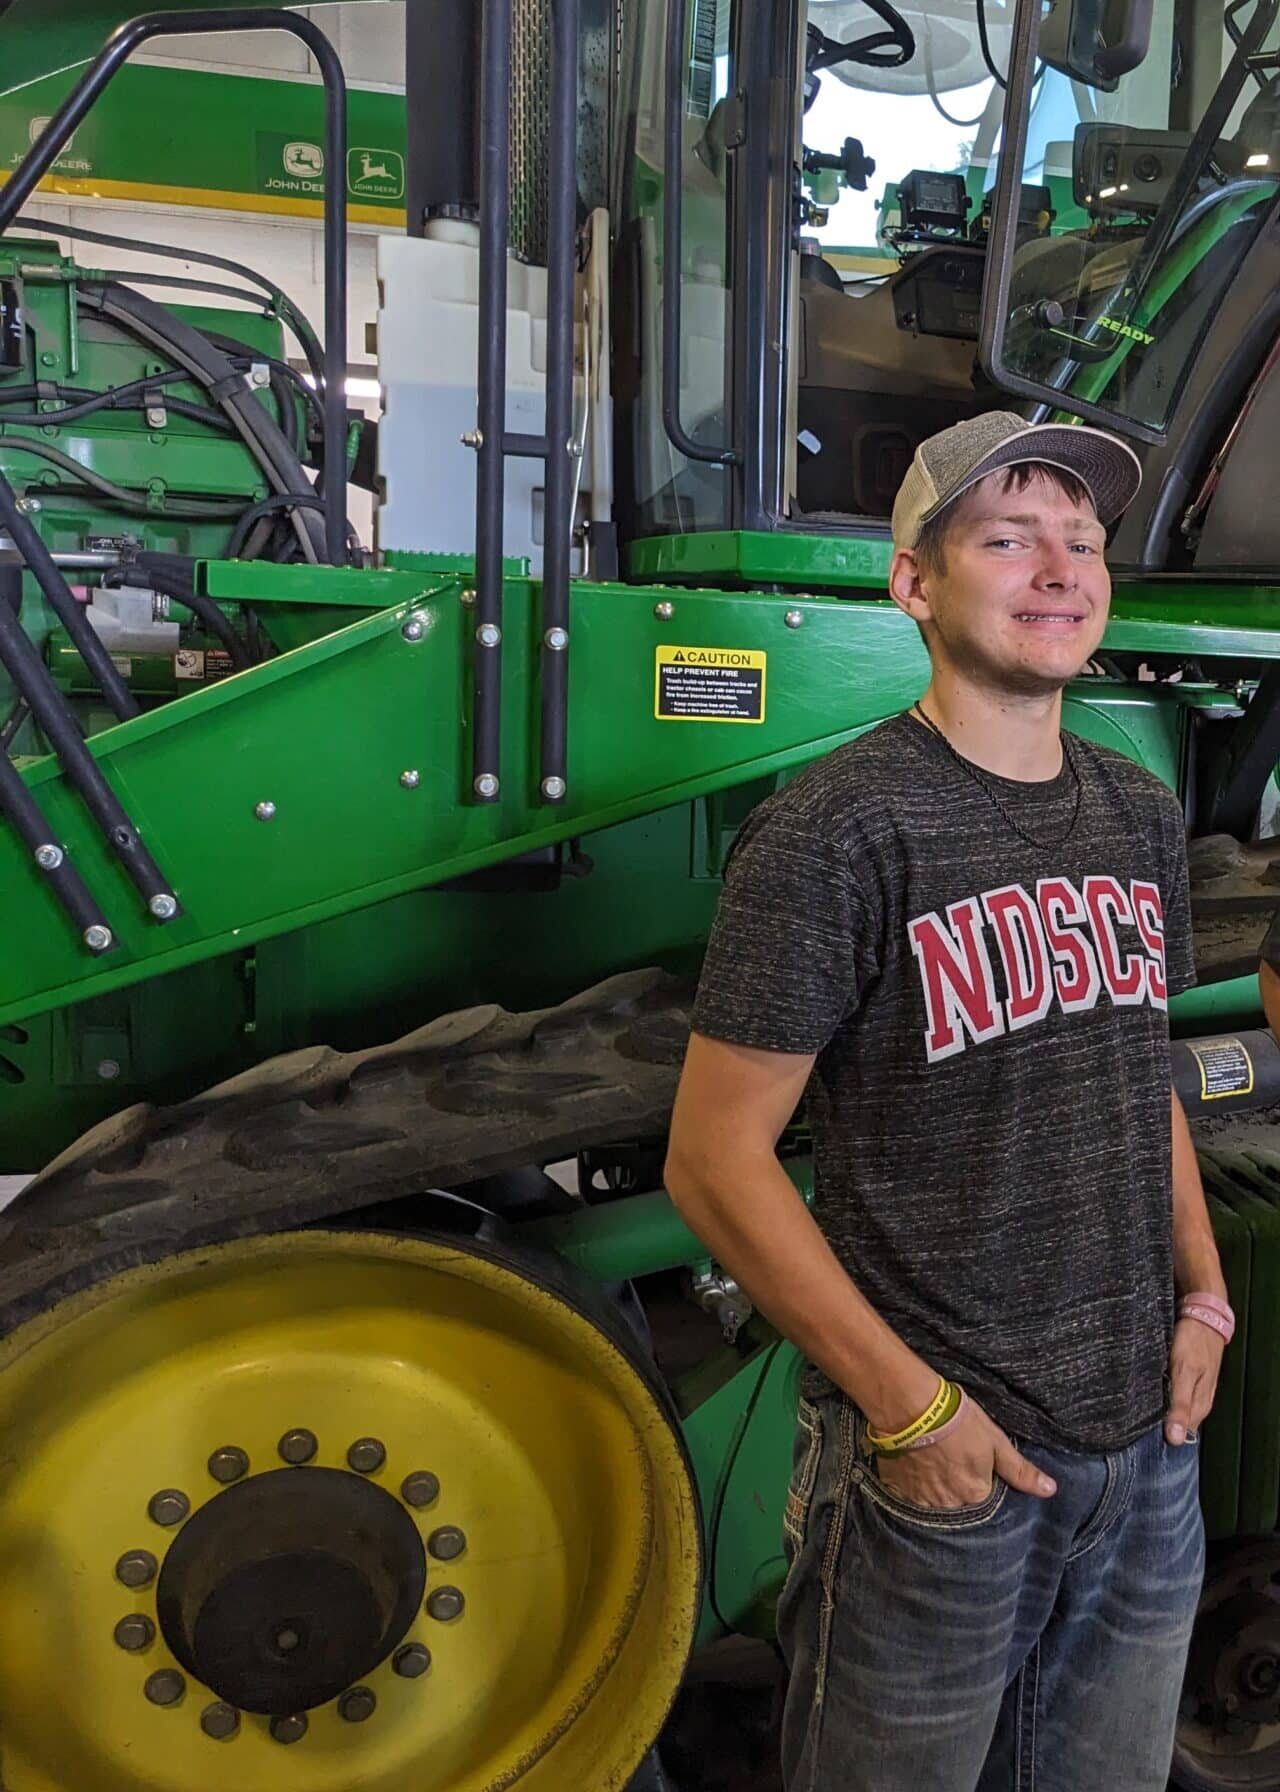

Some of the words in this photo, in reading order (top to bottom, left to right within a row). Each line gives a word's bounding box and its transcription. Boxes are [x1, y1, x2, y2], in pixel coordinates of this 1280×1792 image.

[265, 177, 300, 190] JOHN
[302, 181, 325, 193] DEE
[354, 183, 373, 191] JOHN
[374, 185, 398, 194] DEERE
[1096, 315, 1155, 345] READY
[687, 651, 751, 665] CAUTION
[663, 666, 683, 675] HELP
[684, 668, 720, 677] PREVENT
[721, 670, 739, 678] FIRE
[906, 875, 1168, 1064] NDSCS
